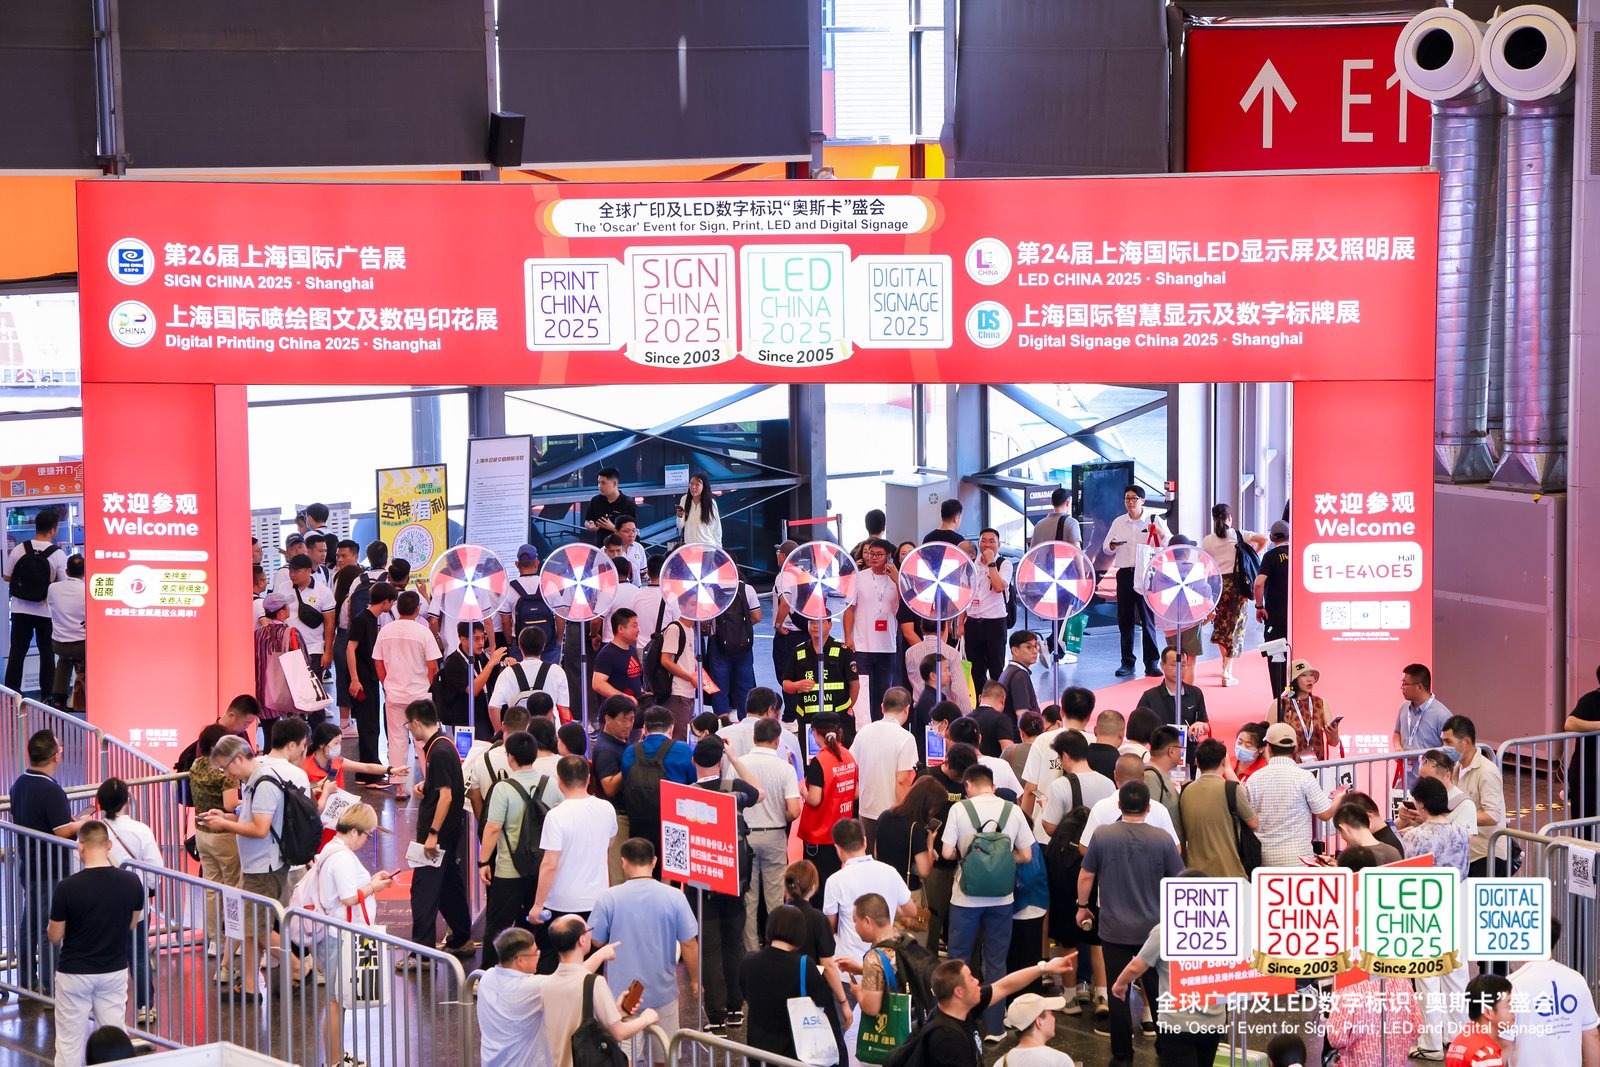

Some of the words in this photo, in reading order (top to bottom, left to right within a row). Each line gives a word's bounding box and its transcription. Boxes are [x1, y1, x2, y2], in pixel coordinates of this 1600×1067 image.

[1341, 58, 1408, 143] E1
[599, 199, 884, 218] 全球广印及LED数字标识“奥斯卡”盛会
[576, 223, 595, 232] The
[600, 223, 639, 232] 'Oscar'
[644, 222, 675, 231] Event
[680, 222, 695, 230] for
[700, 221, 728, 232] Sign,
[733, 221, 762, 229] Print,
[768, 220, 790, 229] LED
[795, 220, 815, 229] and
[821, 220, 856, 231] Digital
[862, 220, 908, 231] Signage
[164, 243, 406, 269] 第26届上海国际广告展
[1017, 237, 1415, 265] 第24届上海国际LED显示屏及照明展
[164, 274, 201, 287] SIGN
[206, 275, 255, 288] CHINA
[258, 276, 292, 289] 2025
[306, 277, 373, 292] Shanghai
[541, 271, 599, 290] PRINT
[643, 258, 718, 289] SIGN
[762, 257, 831, 292] LED
[874, 268, 938, 287] DIGITAL
[1019, 273, 1049, 286] LED
[1054, 273, 1103, 286] CHINA
[1107, 273, 1141, 285] 2025
[1155, 271, 1225, 287] Shanghai
[541, 295, 601, 314] CHINA
[644, 292, 720, 315] CHINA
[761, 296, 830, 318] CHINA
[874, 292, 938, 312] SIGNAGE
[166, 304, 498, 331] 上海国际喷绘图文及数码印花展
[978, 310, 1000, 330] DS
[1017, 300, 1360, 327] 上海国际智慧显示及数字标牌展
[545, 319, 598, 338] 2025
[645, 318, 720, 343] 2025
[763, 322, 831, 344] 2025
[884, 316, 928, 336] 2025
[166, 335, 212, 350] Digital
[217, 336, 274, 352] Printing
[279, 337, 321, 349] China
[326, 337, 359, 350] 2025
[373, 338, 440, 353] Shanghai
[1019, 335, 1065, 350] Digital
[1070, 334, 1130, 350] Signage
[1135, 334, 1178, 346] China
[1183, 333, 1218, 346] 2025
[1232, 332, 1302, 348] Shanghai
[645, 352, 679, 364] Since
[683, 349, 722, 365] 2003
[757, 350, 793, 365] Since
[797, 348, 835, 365] 2005
[103, 493, 197, 514] 欢迎参观
[381, 496, 445, 522] 空降福利
[1315, 492, 1415, 514] 欢迎参观
[104, 518, 198, 536] Welcome
[1315, 518, 1415, 536] Welcome
[1312, 554, 1319, 562] 馆
[1314, 564, 1412, 579] E1-E4\OE5
[95, 577, 114, 586] 全面
[95, 587, 113, 596] 招商
[804, 694, 817, 702] BAO
[840, 801, 852, 813] STAFF
